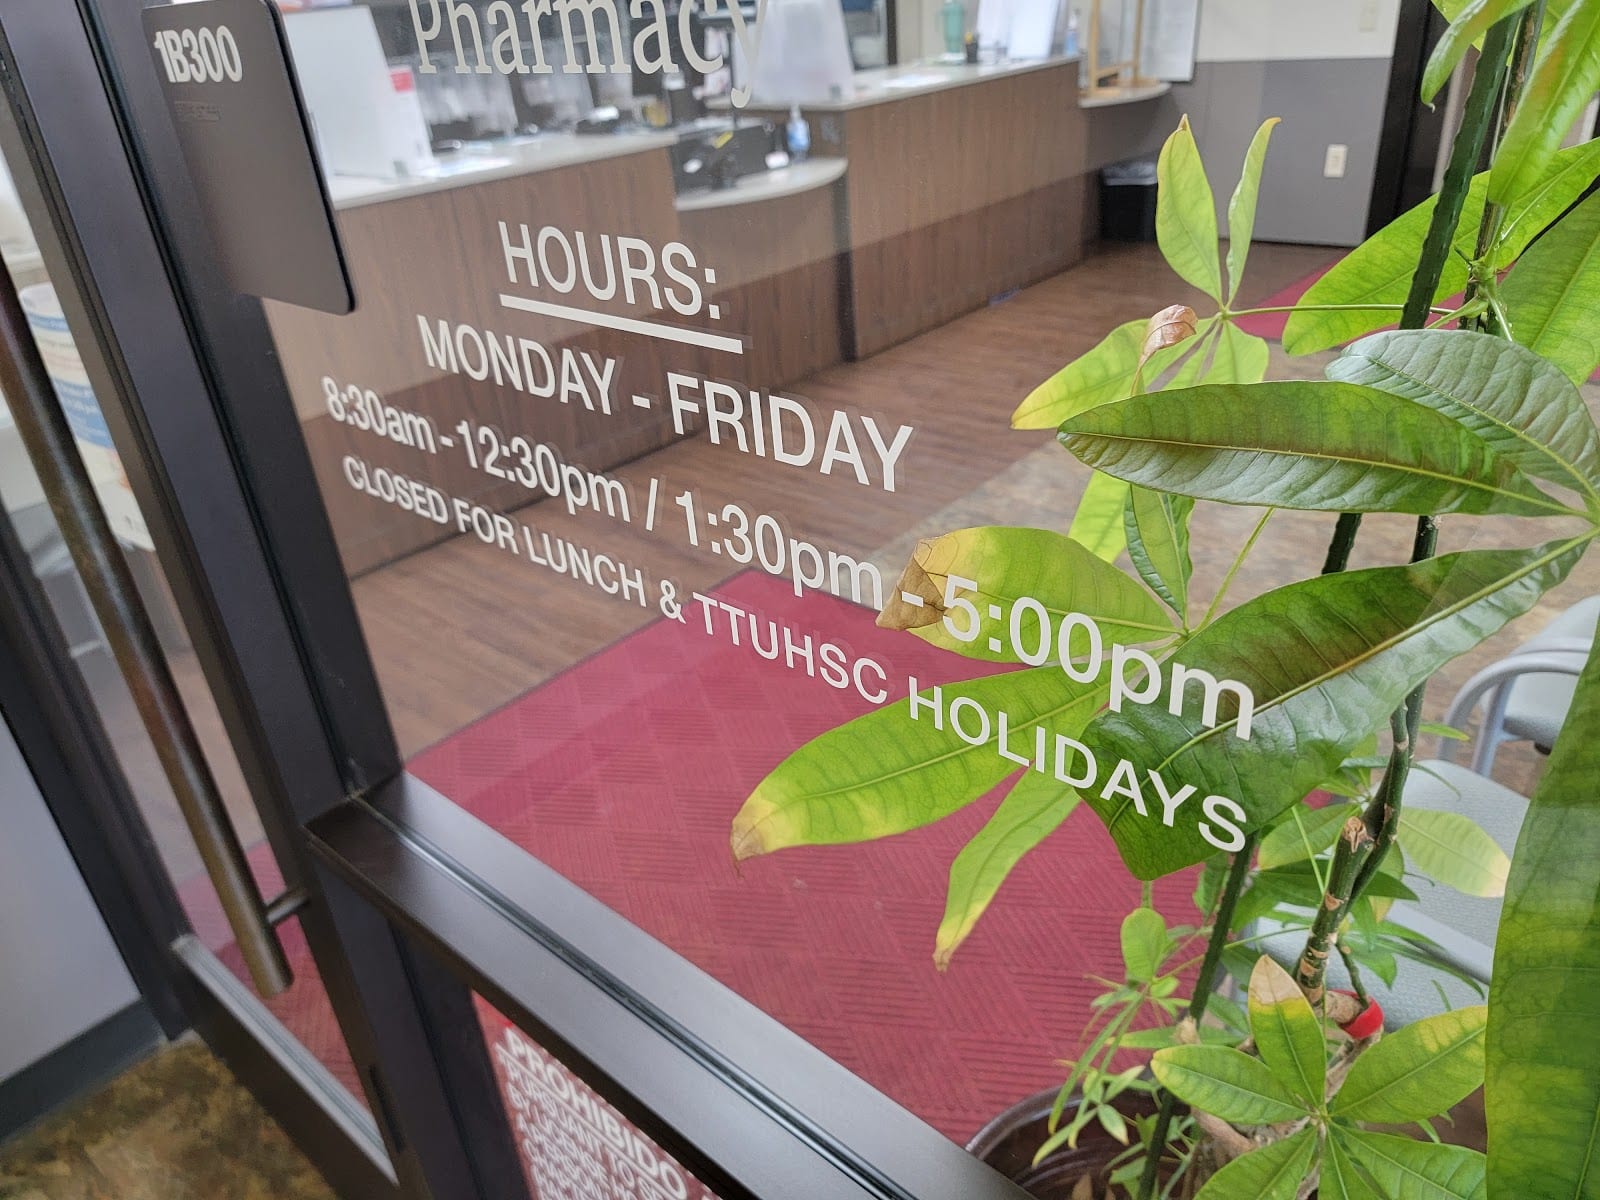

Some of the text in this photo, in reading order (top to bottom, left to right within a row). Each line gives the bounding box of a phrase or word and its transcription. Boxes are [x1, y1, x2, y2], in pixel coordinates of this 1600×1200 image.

[153, 25, 242, 83] 1B300
[410, 0, 767, 108] Pharmacy
[498, 220, 721, 320] HOURS:
[417, 314, 616, 415] MONDAY
[667, 371, 914, 492] FRIDAY
[343, 456, 1247, 853] CLOSED FOR LUNCH & TTUHSC HOLIDAYS
[675, 491, 883, 611] 1:30pm
[942, 575, 1256, 741] 5:00pm
[504, 1027, 688, 1200] PROHIBIDO
